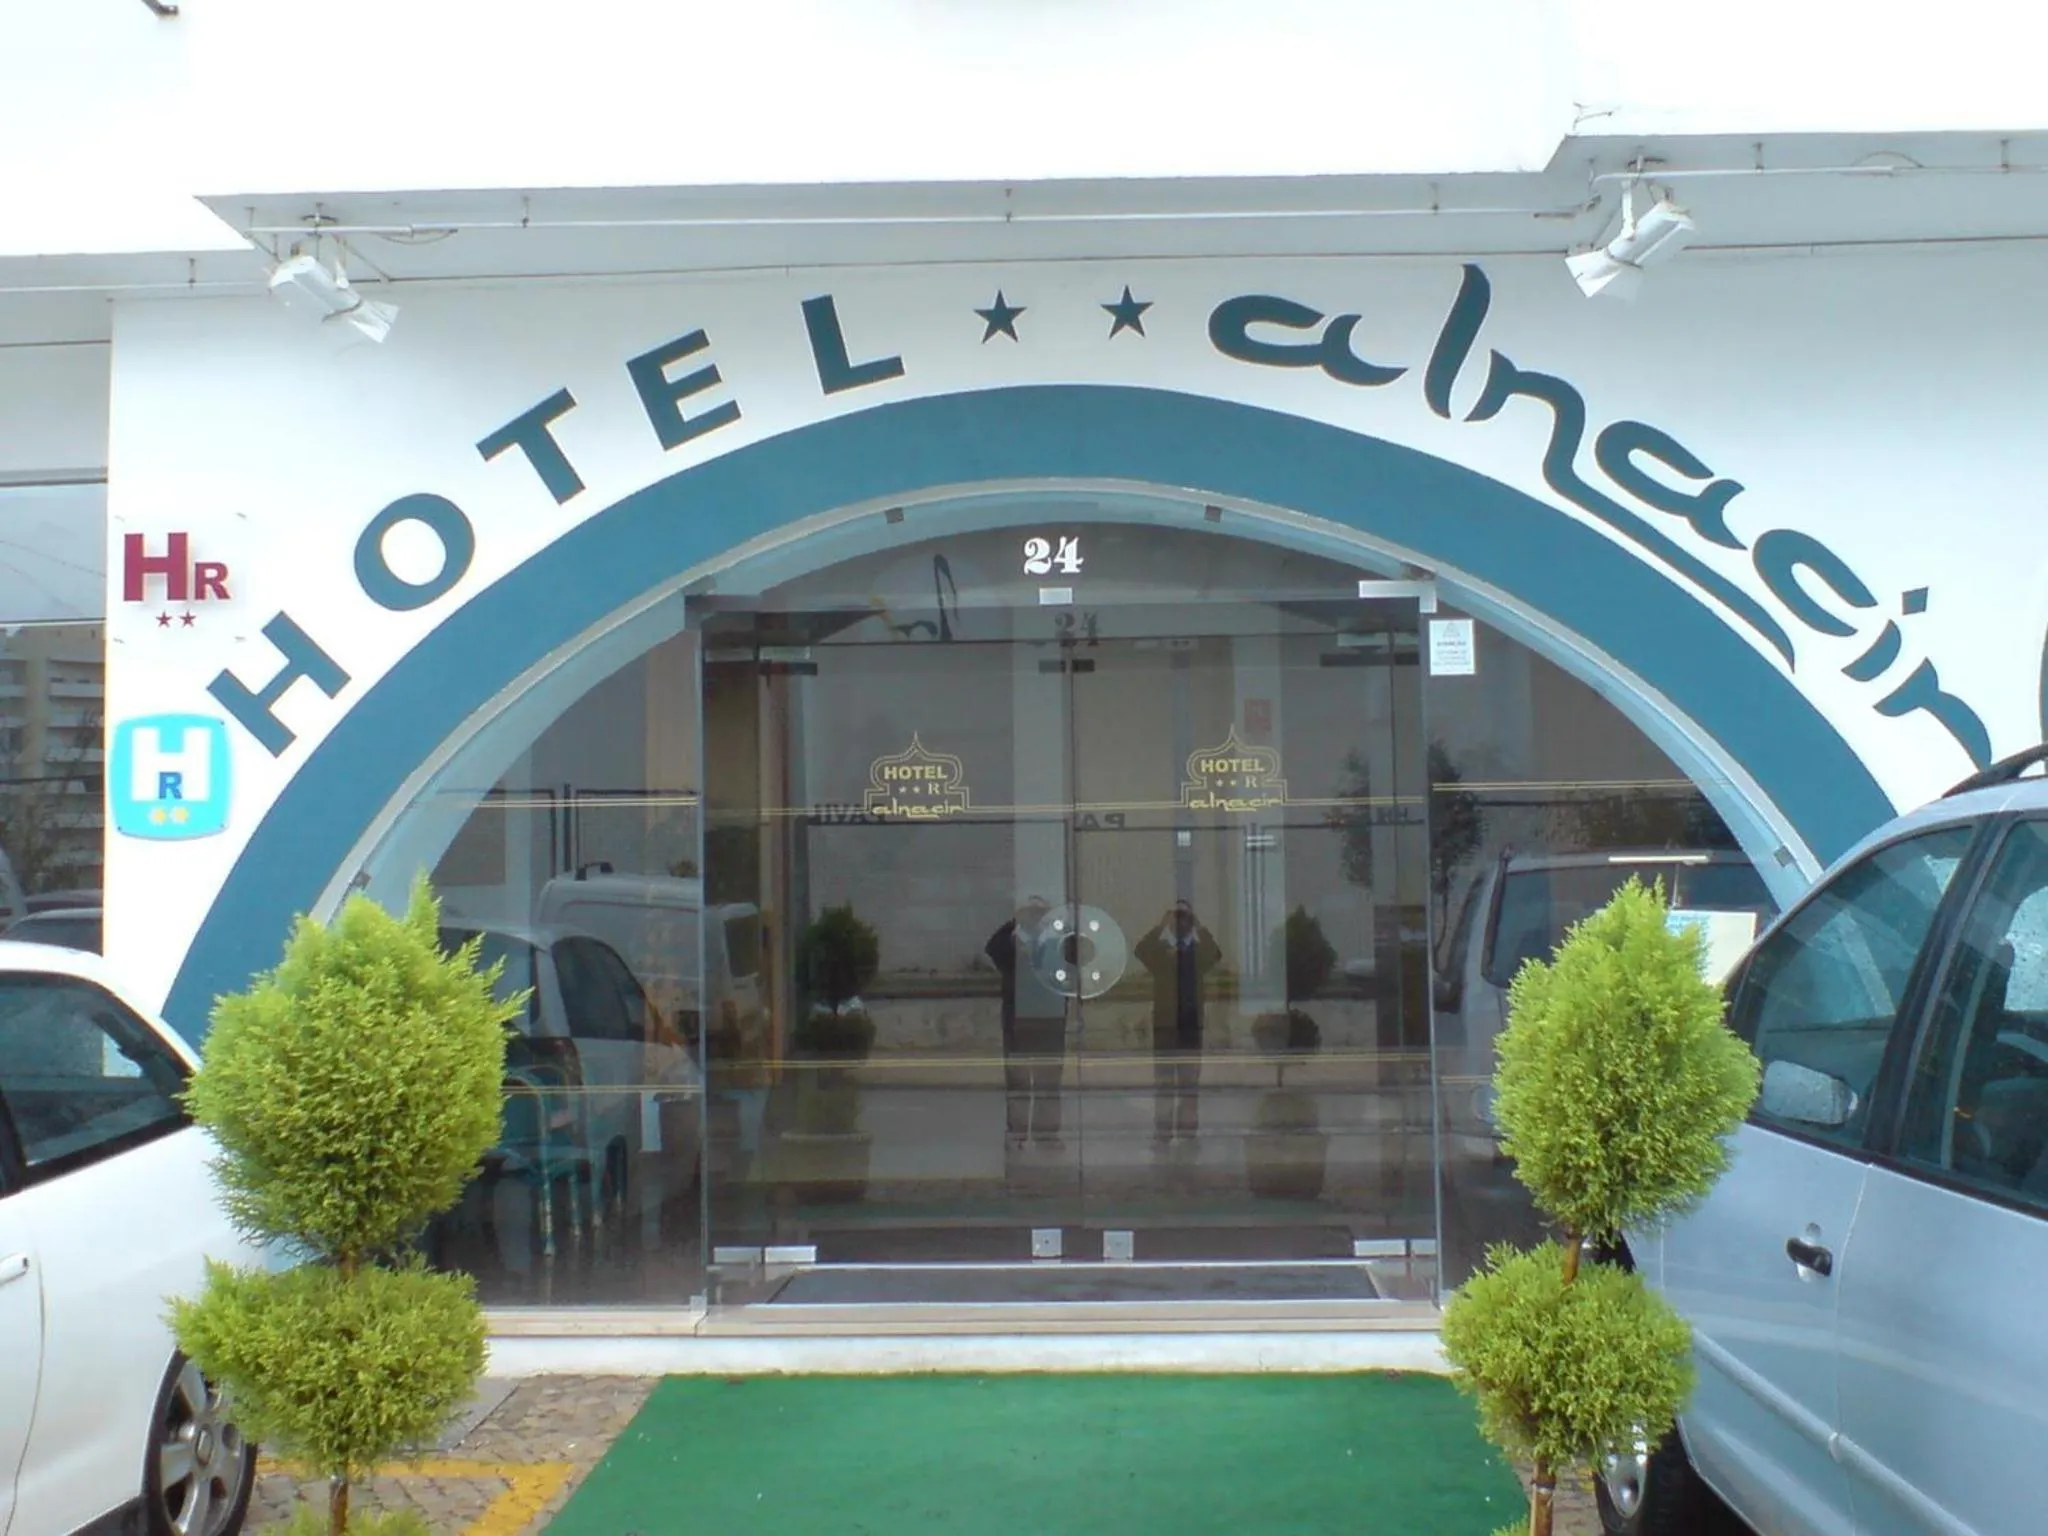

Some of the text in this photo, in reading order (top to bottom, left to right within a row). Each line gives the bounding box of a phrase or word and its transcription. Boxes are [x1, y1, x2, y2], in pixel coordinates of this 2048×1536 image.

[206, 263, 1992, 771] HOTEL alnacir
[1022, 535, 1085, 575] 24
[883, 765, 948, 780] HOTEL
[1200, 758, 1265, 773] HOTEL
[927, 782, 942, 795] R
[1245, 775, 1258, 788] R
[871, 796, 966, 818] alnacir
[1189, 791, 1282, 812] alnacir
